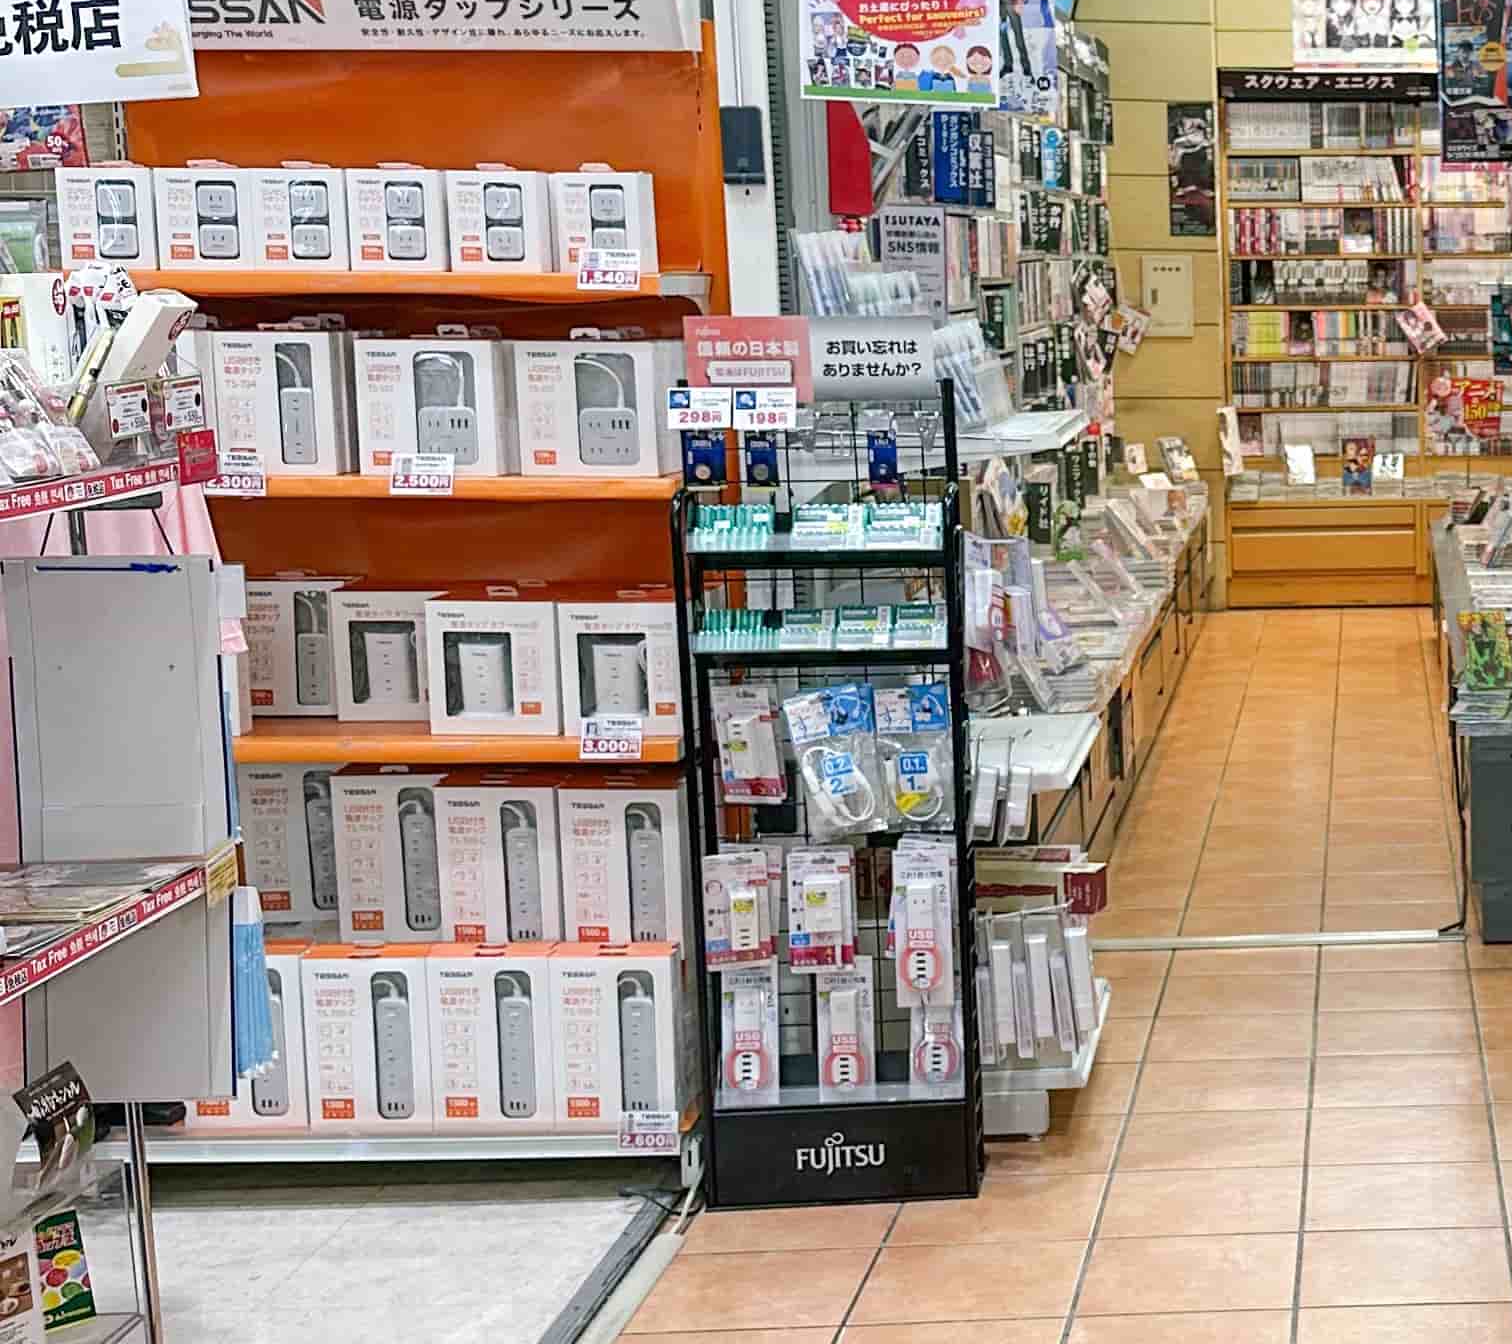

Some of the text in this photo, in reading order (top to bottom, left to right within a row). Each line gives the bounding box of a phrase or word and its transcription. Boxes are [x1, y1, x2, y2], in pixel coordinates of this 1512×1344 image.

[825, 340, 918, 356] お買い忘れは
[796, 1132, 886, 1178] FUJITSU
